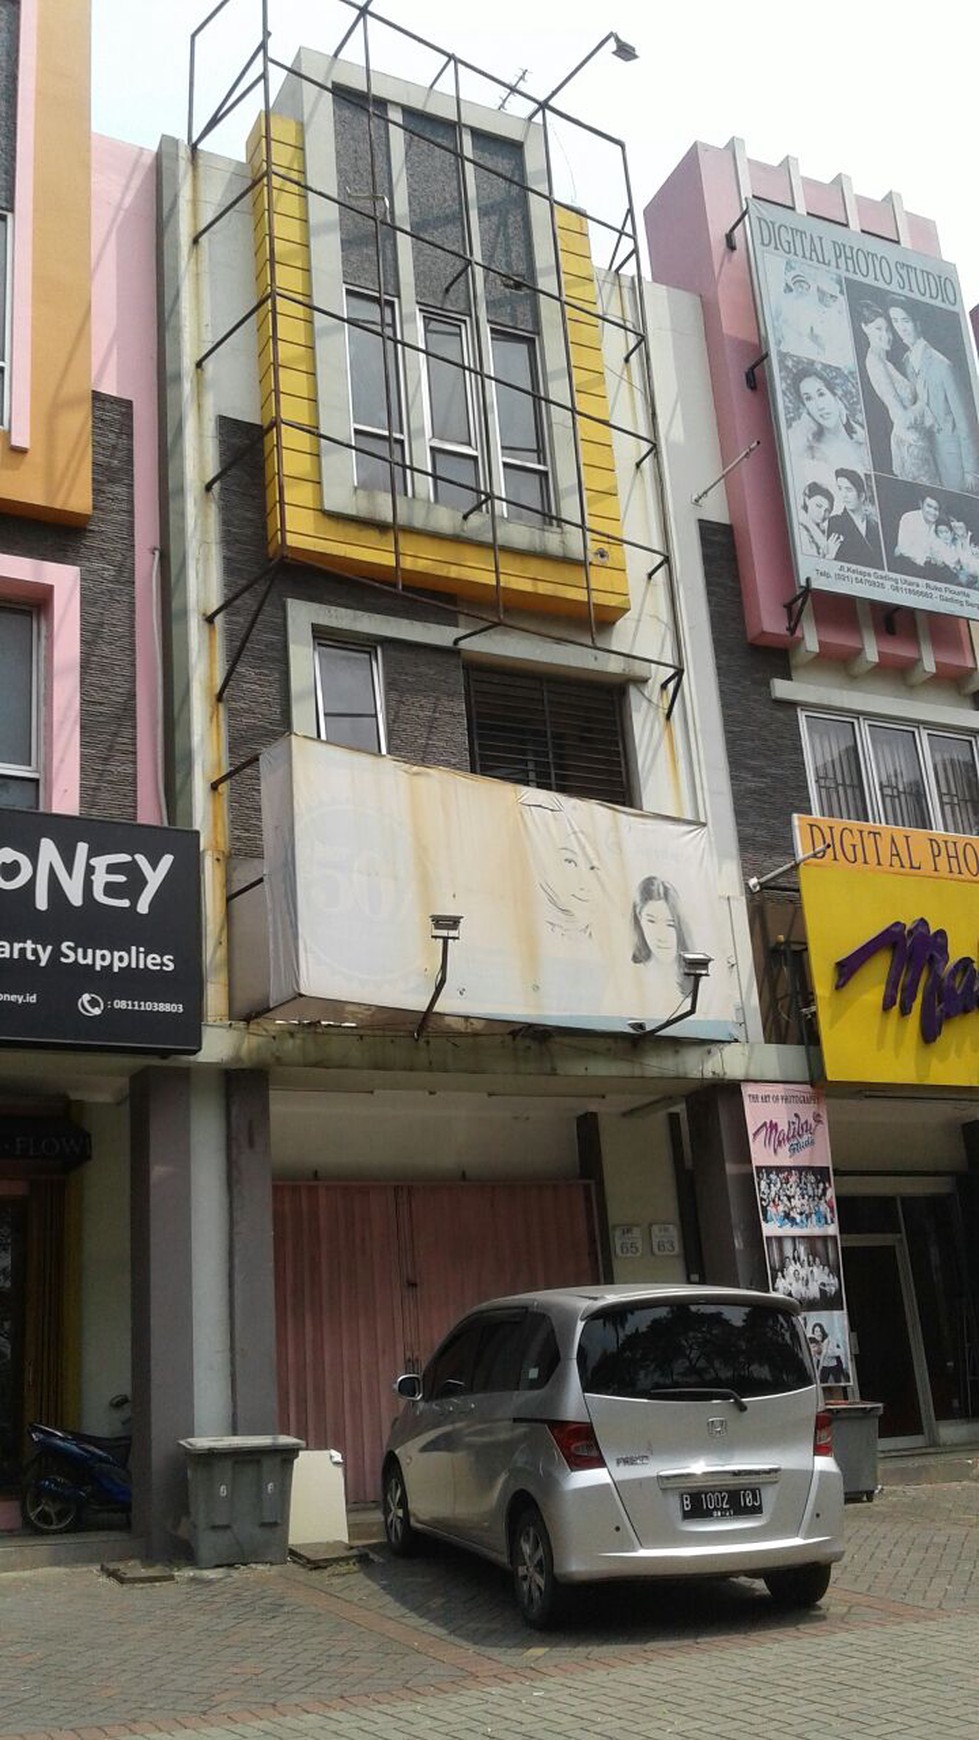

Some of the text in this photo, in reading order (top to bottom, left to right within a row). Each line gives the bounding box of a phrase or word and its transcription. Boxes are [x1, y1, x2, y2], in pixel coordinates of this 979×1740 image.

[755, 215, 958, 307] DIGITAL PHOTO STUDIO
[806, 823, 979, 877] DIGITAL PHO
[60, 941, 175, 972] Supplies
[752, 1112, 813, 1157] Malibu
[620, 1241, 639, 1255] 65
[657, 1239, 676, 1253] 63
[683, 1494, 692, 1511] B
[701, 1492, 730, 1510] 1002
